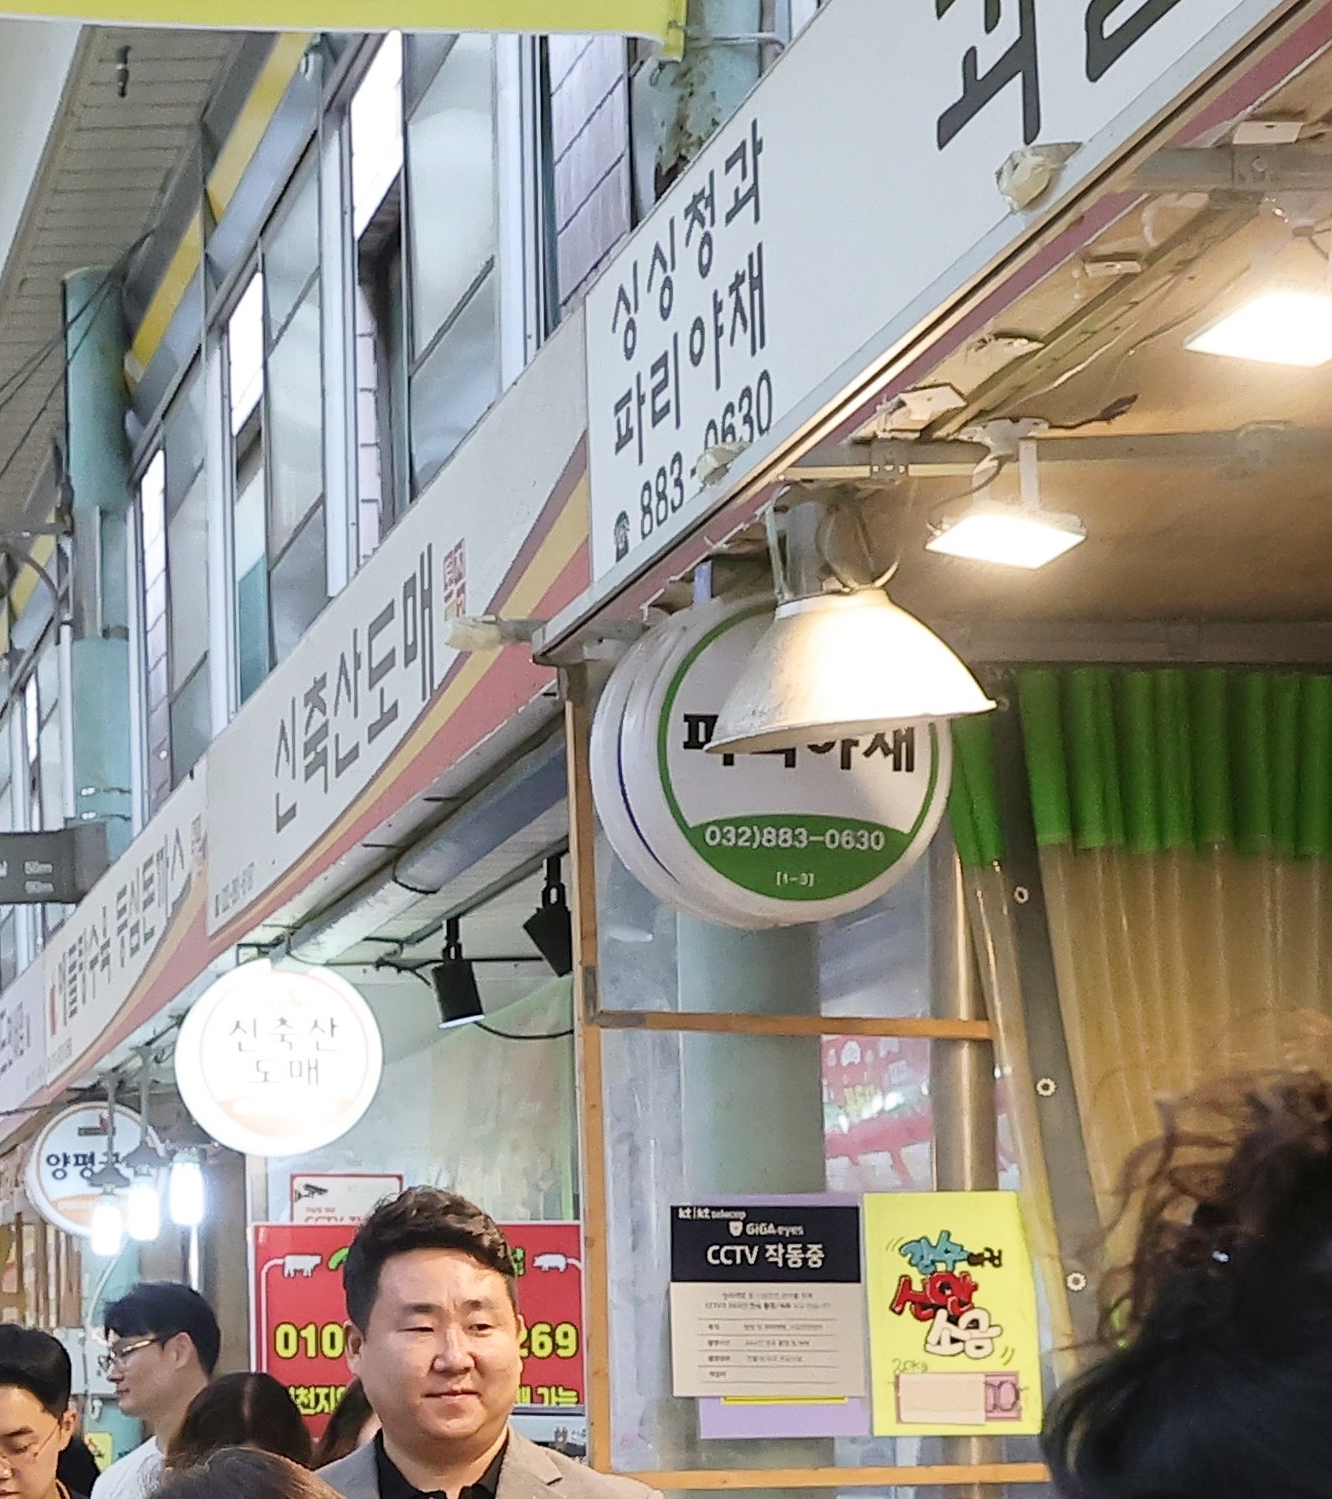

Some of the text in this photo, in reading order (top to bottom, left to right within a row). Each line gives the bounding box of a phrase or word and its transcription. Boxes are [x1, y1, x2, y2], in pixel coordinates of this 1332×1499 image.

[612, 117, 763, 362] 싱싱청과
[614, 240, 767, 467] 파리야채
[274, 542, 436, 834] 신축산도매
[704, 825, 886, 851] 032)883-0630
[229, 1016, 339, 1053] 신축산
[249, 1057, 320, 1087] 도매
[707, 1242, 826, 1269] CCTV 작동중
